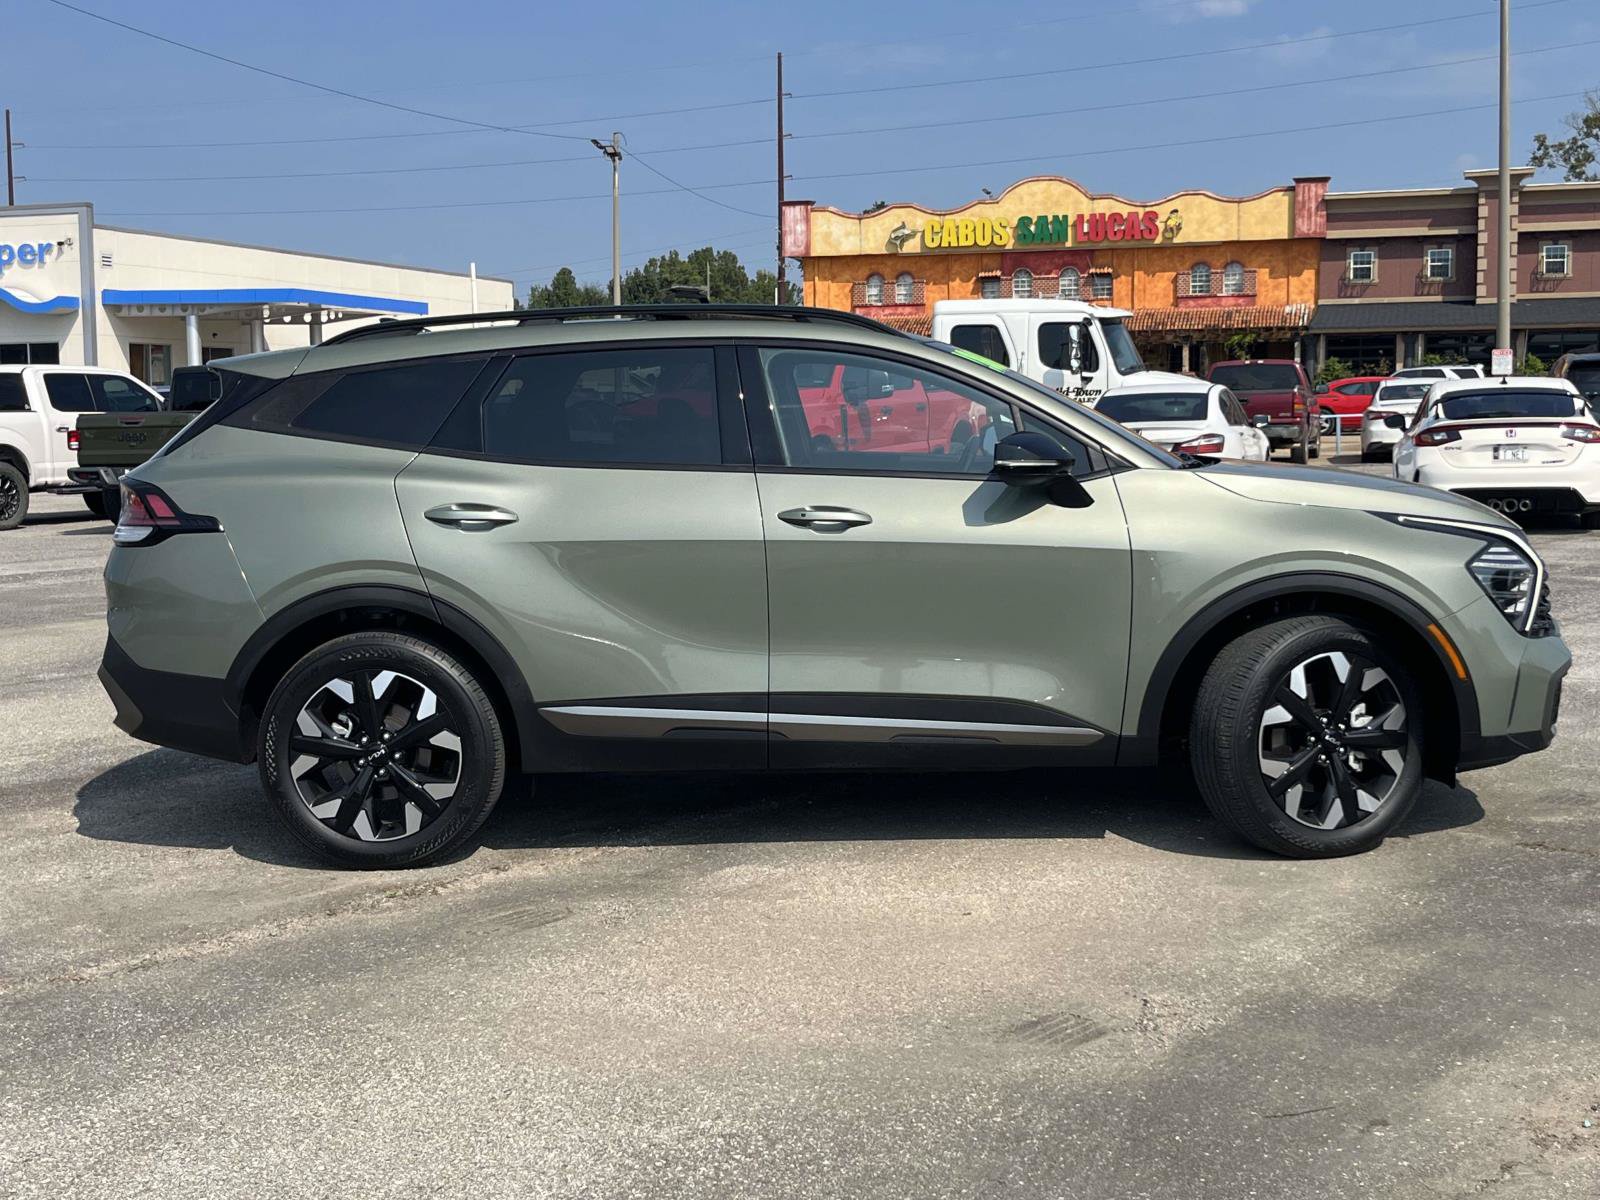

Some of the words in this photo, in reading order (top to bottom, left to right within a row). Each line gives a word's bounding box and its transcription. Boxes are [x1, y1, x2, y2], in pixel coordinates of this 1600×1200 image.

[923, 217, 1010, 249] CABOS
[1016, 214, 1069, 245] SAN
[1076, 210, 1160, 243] LUCAS
[1073, 386, 1102, 397] Town
